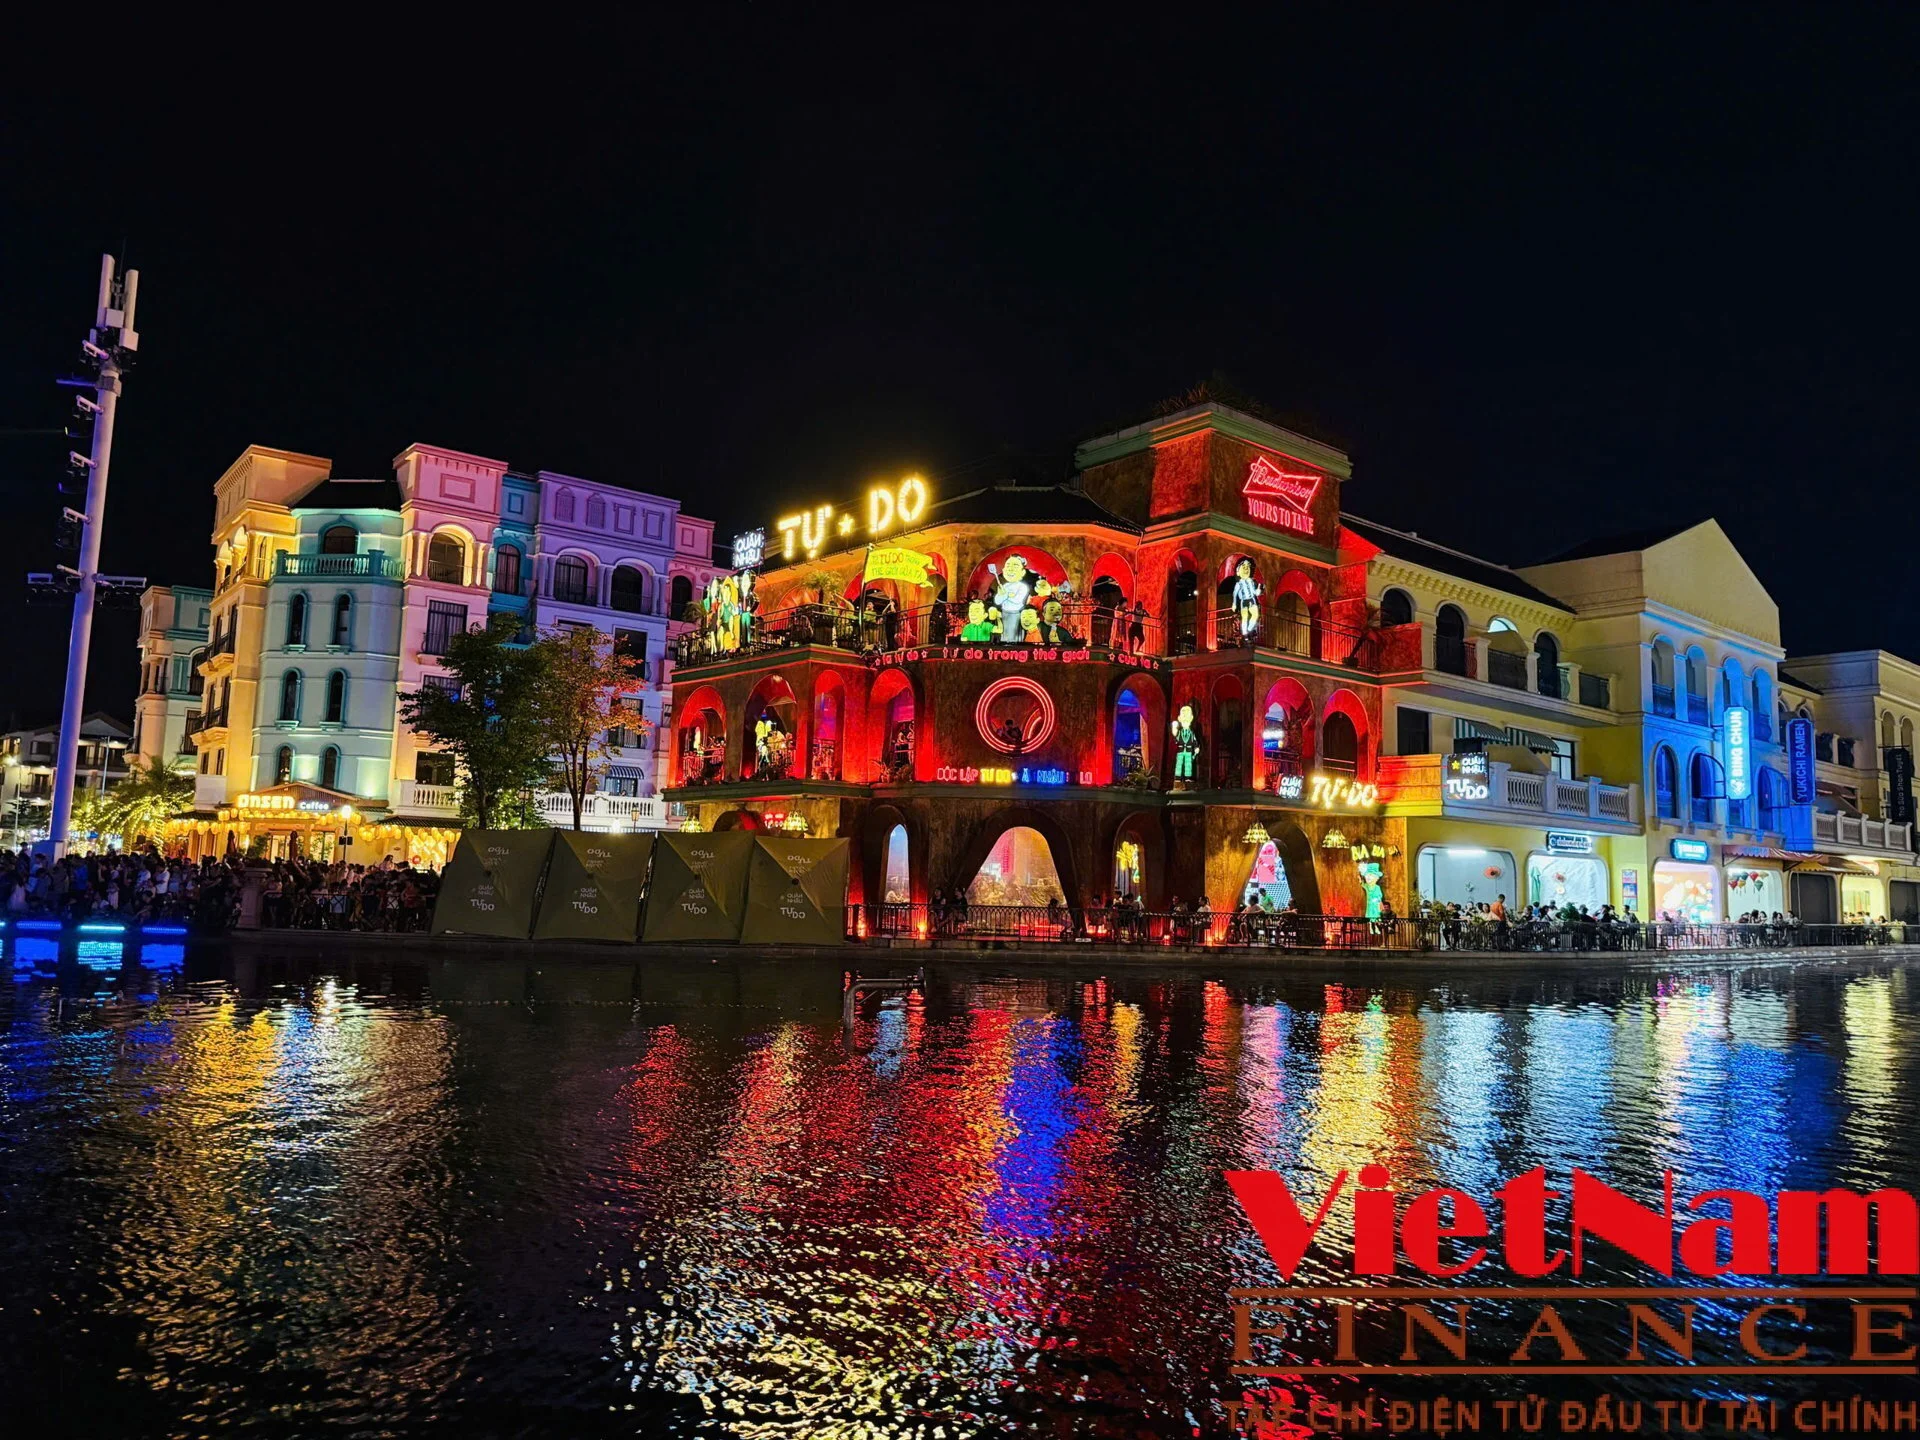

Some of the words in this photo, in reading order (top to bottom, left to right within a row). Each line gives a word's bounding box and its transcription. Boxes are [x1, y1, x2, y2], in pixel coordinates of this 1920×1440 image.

[1250, 463, 1313, 499] Budweiser
[777, 503, 833, 560] TỰ
[868, 478, 927, 534] DO
[1247, 497, 1278, 523] YOURS
[1279, 508, 1291, 527] TO
[1291, 512, 1314, 535] TAKE
[735, 531, 763, 553] QUÁN
[964, 647, 984, 660] do
[988, 648, 1029, 663] trong
[1033, 647, 1057, 661] thế
[1729, 711, 1744, 745] CHUN
[1794, 723, 1806, 758] RAMEN
[1730, 747, 1744, 777] BING
[1311, 776, 1346, 809] TỰ
[1347, 781, 1379, 806] DO
[1446, 778, 1470, 797] TỰ
[1465, 784, 1488, 800] DO
[1795, 760, 1808, 799] YUKICHI
[481, 903, 495, 911] DO
[584, 906, 598, 914] DO
[693, 907, 707, 915] DO
